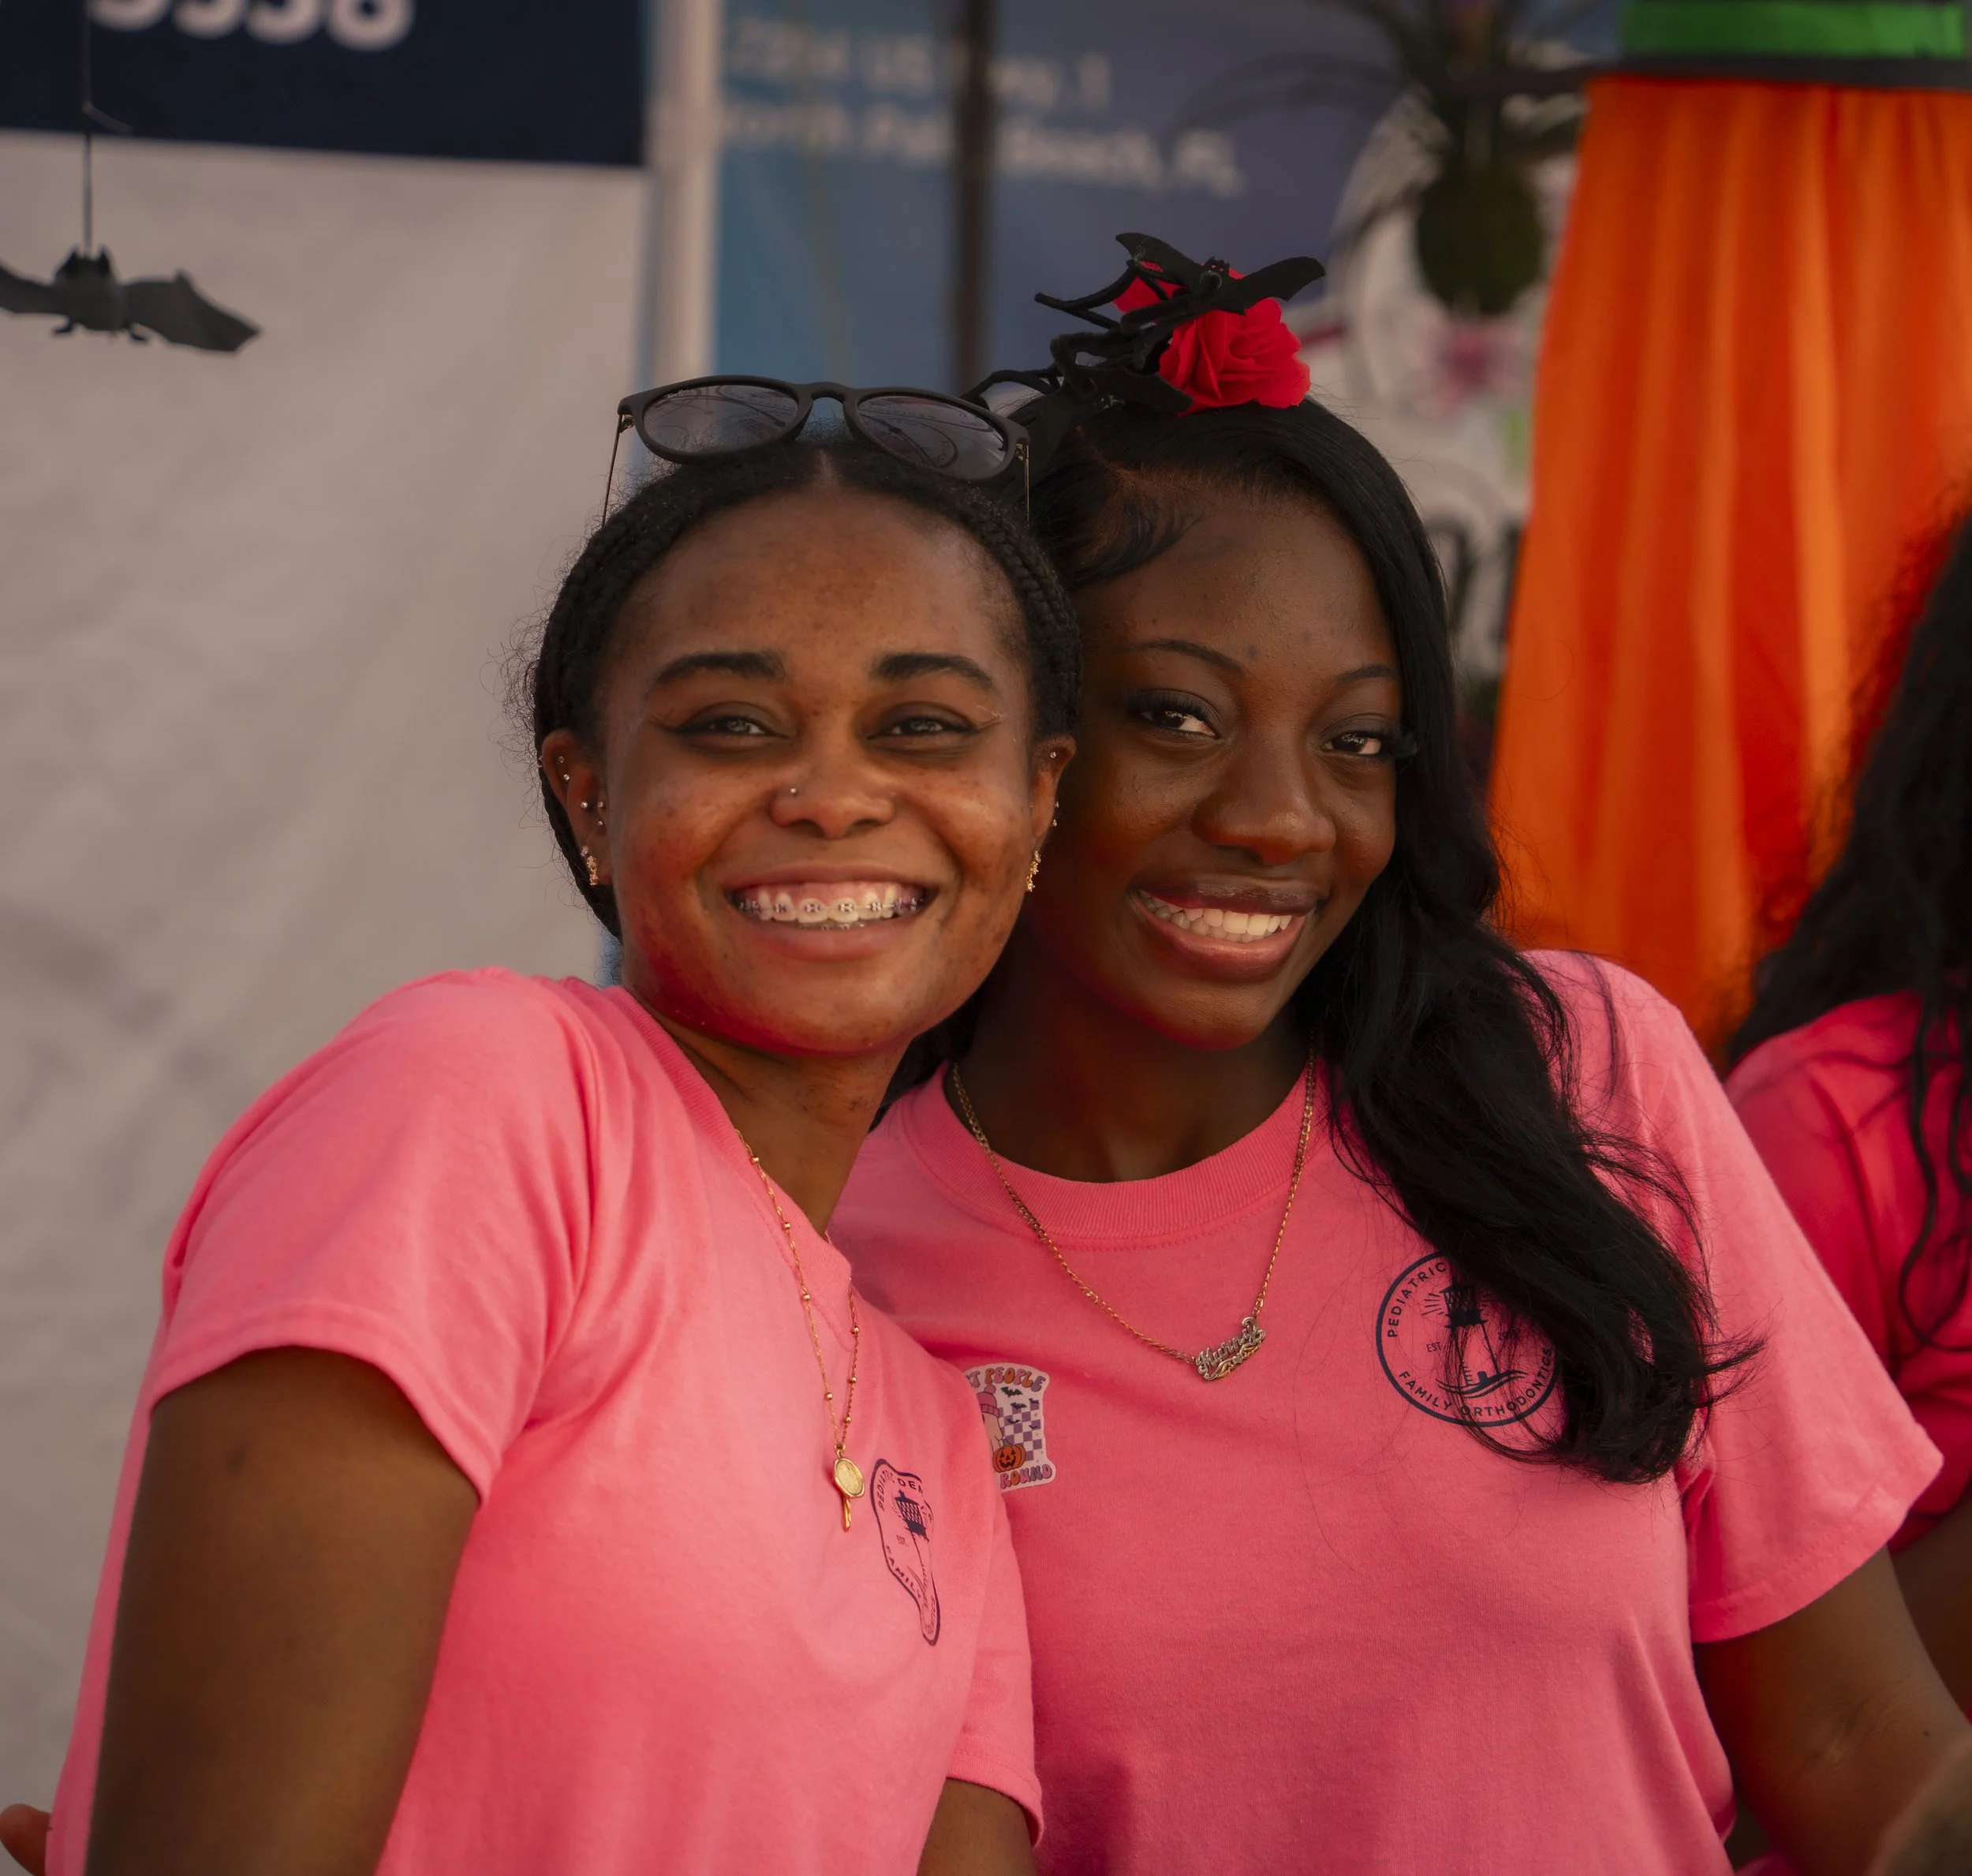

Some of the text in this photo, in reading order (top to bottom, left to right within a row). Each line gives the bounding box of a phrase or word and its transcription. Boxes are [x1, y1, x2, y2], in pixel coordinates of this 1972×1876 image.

[1387, 1262, 1447, 1338] PEDIATRIC
[984, 1366, 1047, 1392] PEOPLE
[1399, 1346, 1553, 1417] FAMILY ORTHODONTICS
